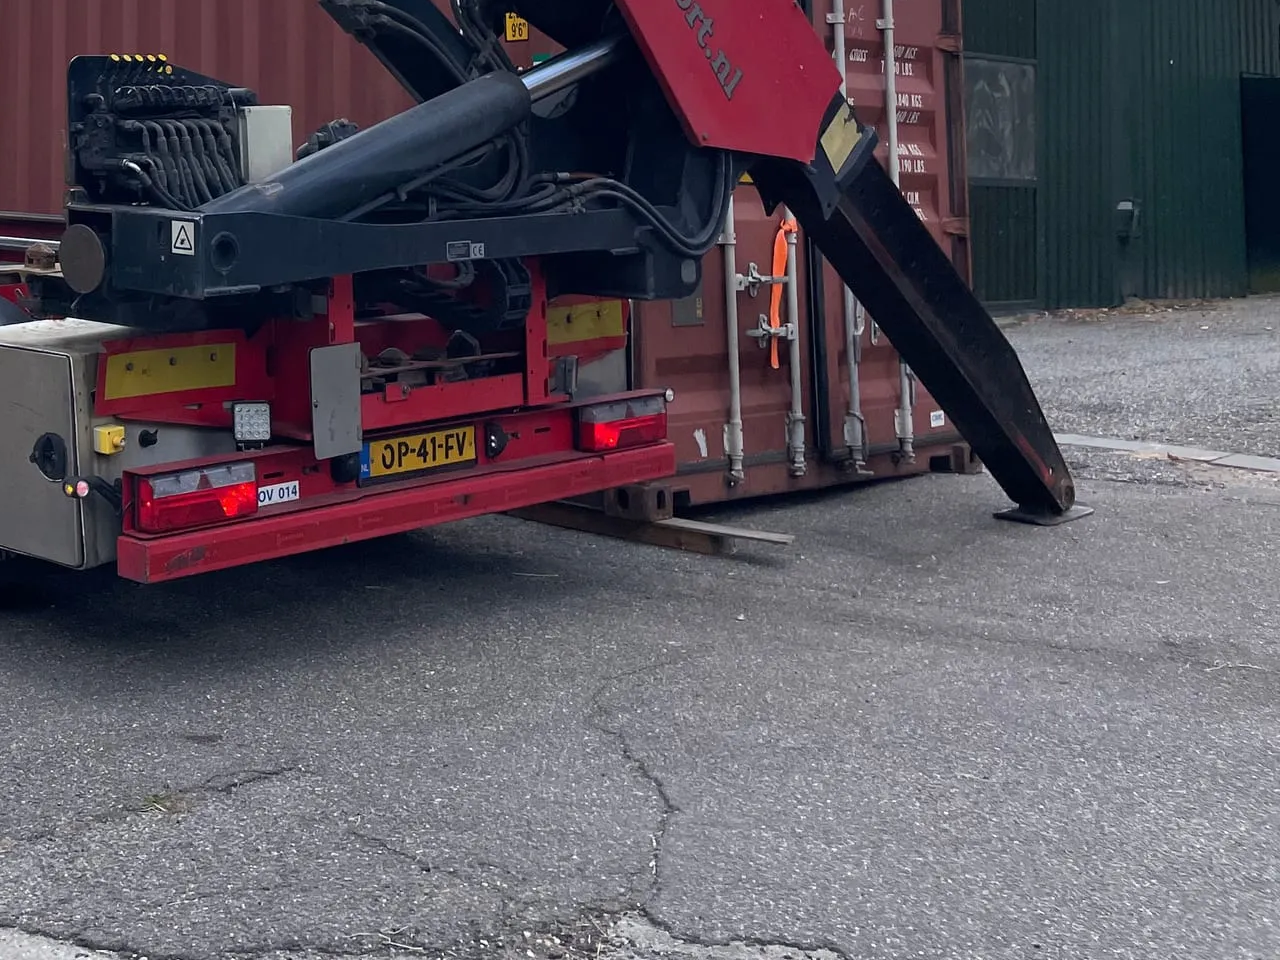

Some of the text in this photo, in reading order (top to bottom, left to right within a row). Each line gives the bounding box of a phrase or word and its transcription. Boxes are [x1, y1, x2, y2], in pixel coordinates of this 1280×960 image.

[360, 431, 468, 473] NL OP-41-FV
[258, 484, 297, 503] OV 014
